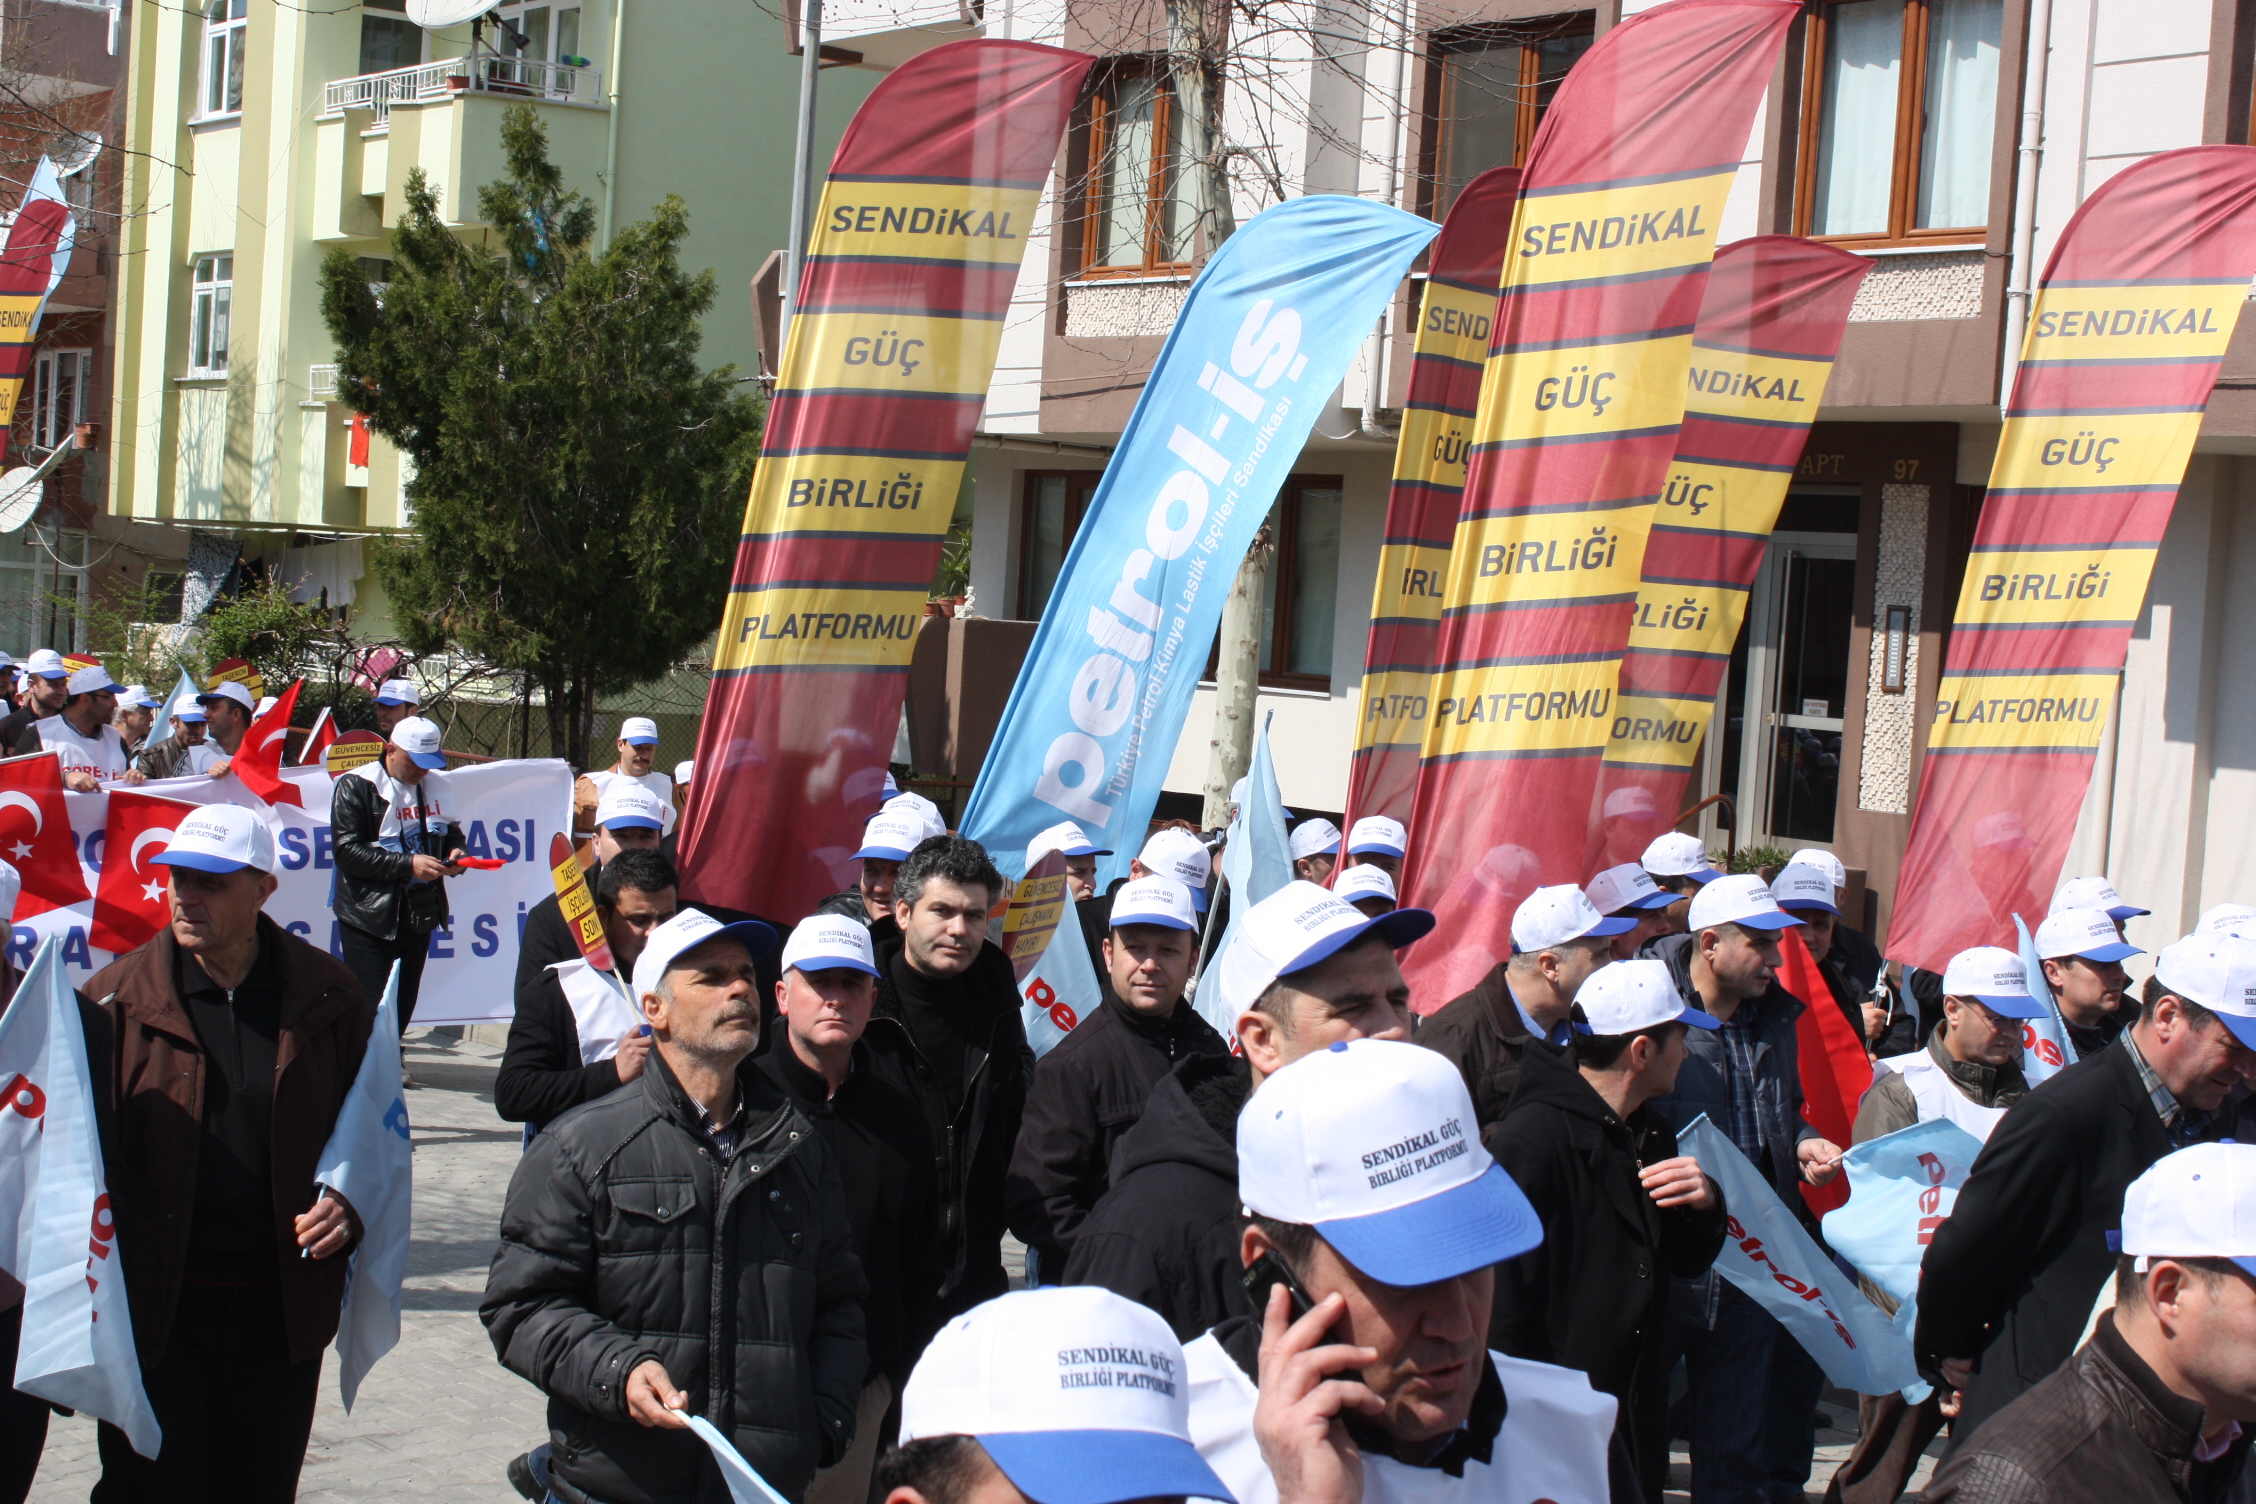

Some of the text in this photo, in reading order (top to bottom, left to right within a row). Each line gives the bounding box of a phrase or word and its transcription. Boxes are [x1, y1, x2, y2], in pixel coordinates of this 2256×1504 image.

[844, 330, 924, 375] GÜÇ
[1534, 366, 1617, 416] GÜÇ
[1801, 454, 1920, 480] APT 97
[2040, 431, 2120, 473] GÜÇ
[1032, 300, 1308, 828] petrol-iş
[1105, 396, 1292, 797] Türkiye Petrol Kimya Lastik İşçileri Sendikası
[739, 613, 916, 643] PLATFORMU
[1434, 688, 1611, 728] PLATFORMU
[1933, 697, 2099, 725] PLATFORMU
[214, 825, 229, 836] GÜÇ
[1361, 1118, 1463, 1169] SENDİKAL GÜÇ
[1368, 1138, 1468, 1189] BİRLİĞİ PLATFORMU
[1058, 1342, 1175, 1380] SENDİKAL GÜÇ
[1060, 1366, 1113, 1389] BİRLİĞİ
